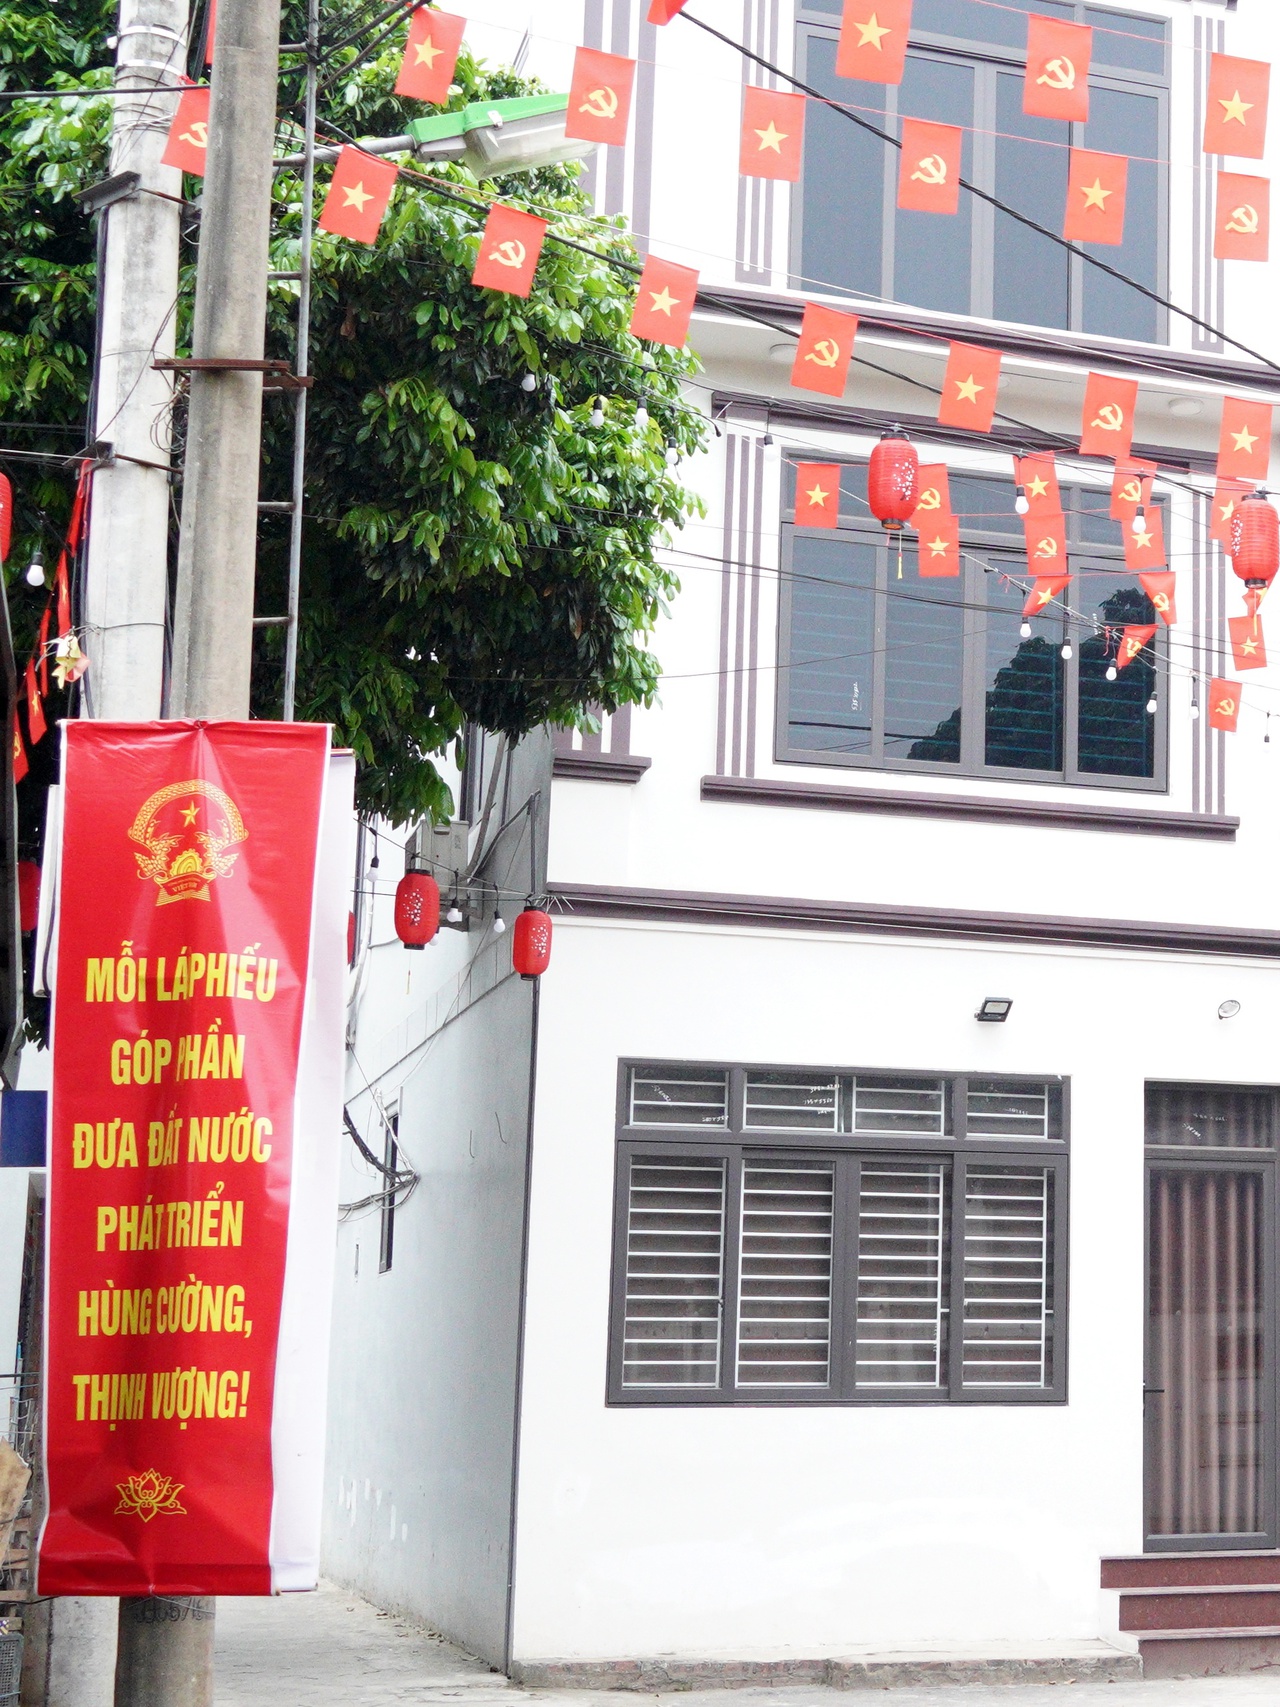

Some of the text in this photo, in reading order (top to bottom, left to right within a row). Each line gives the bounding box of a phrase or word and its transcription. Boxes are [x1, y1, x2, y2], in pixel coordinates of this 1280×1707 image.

[86, 940, 278, 1002] MỖI LÁ PHIẾU
[110, 1017, 246, 1085] GÓP PHẦN
[72, 1102, 273, 1169] ĐƯA ĐẤT NƯỚC
[97, 1181, 244, 1252] PHÁT TRIỂN
[78, 1273, 253, 1338] HÙNG CƯỜNG,
[73, 1366, 251, 1431] THỊNH VƯỢNG!
